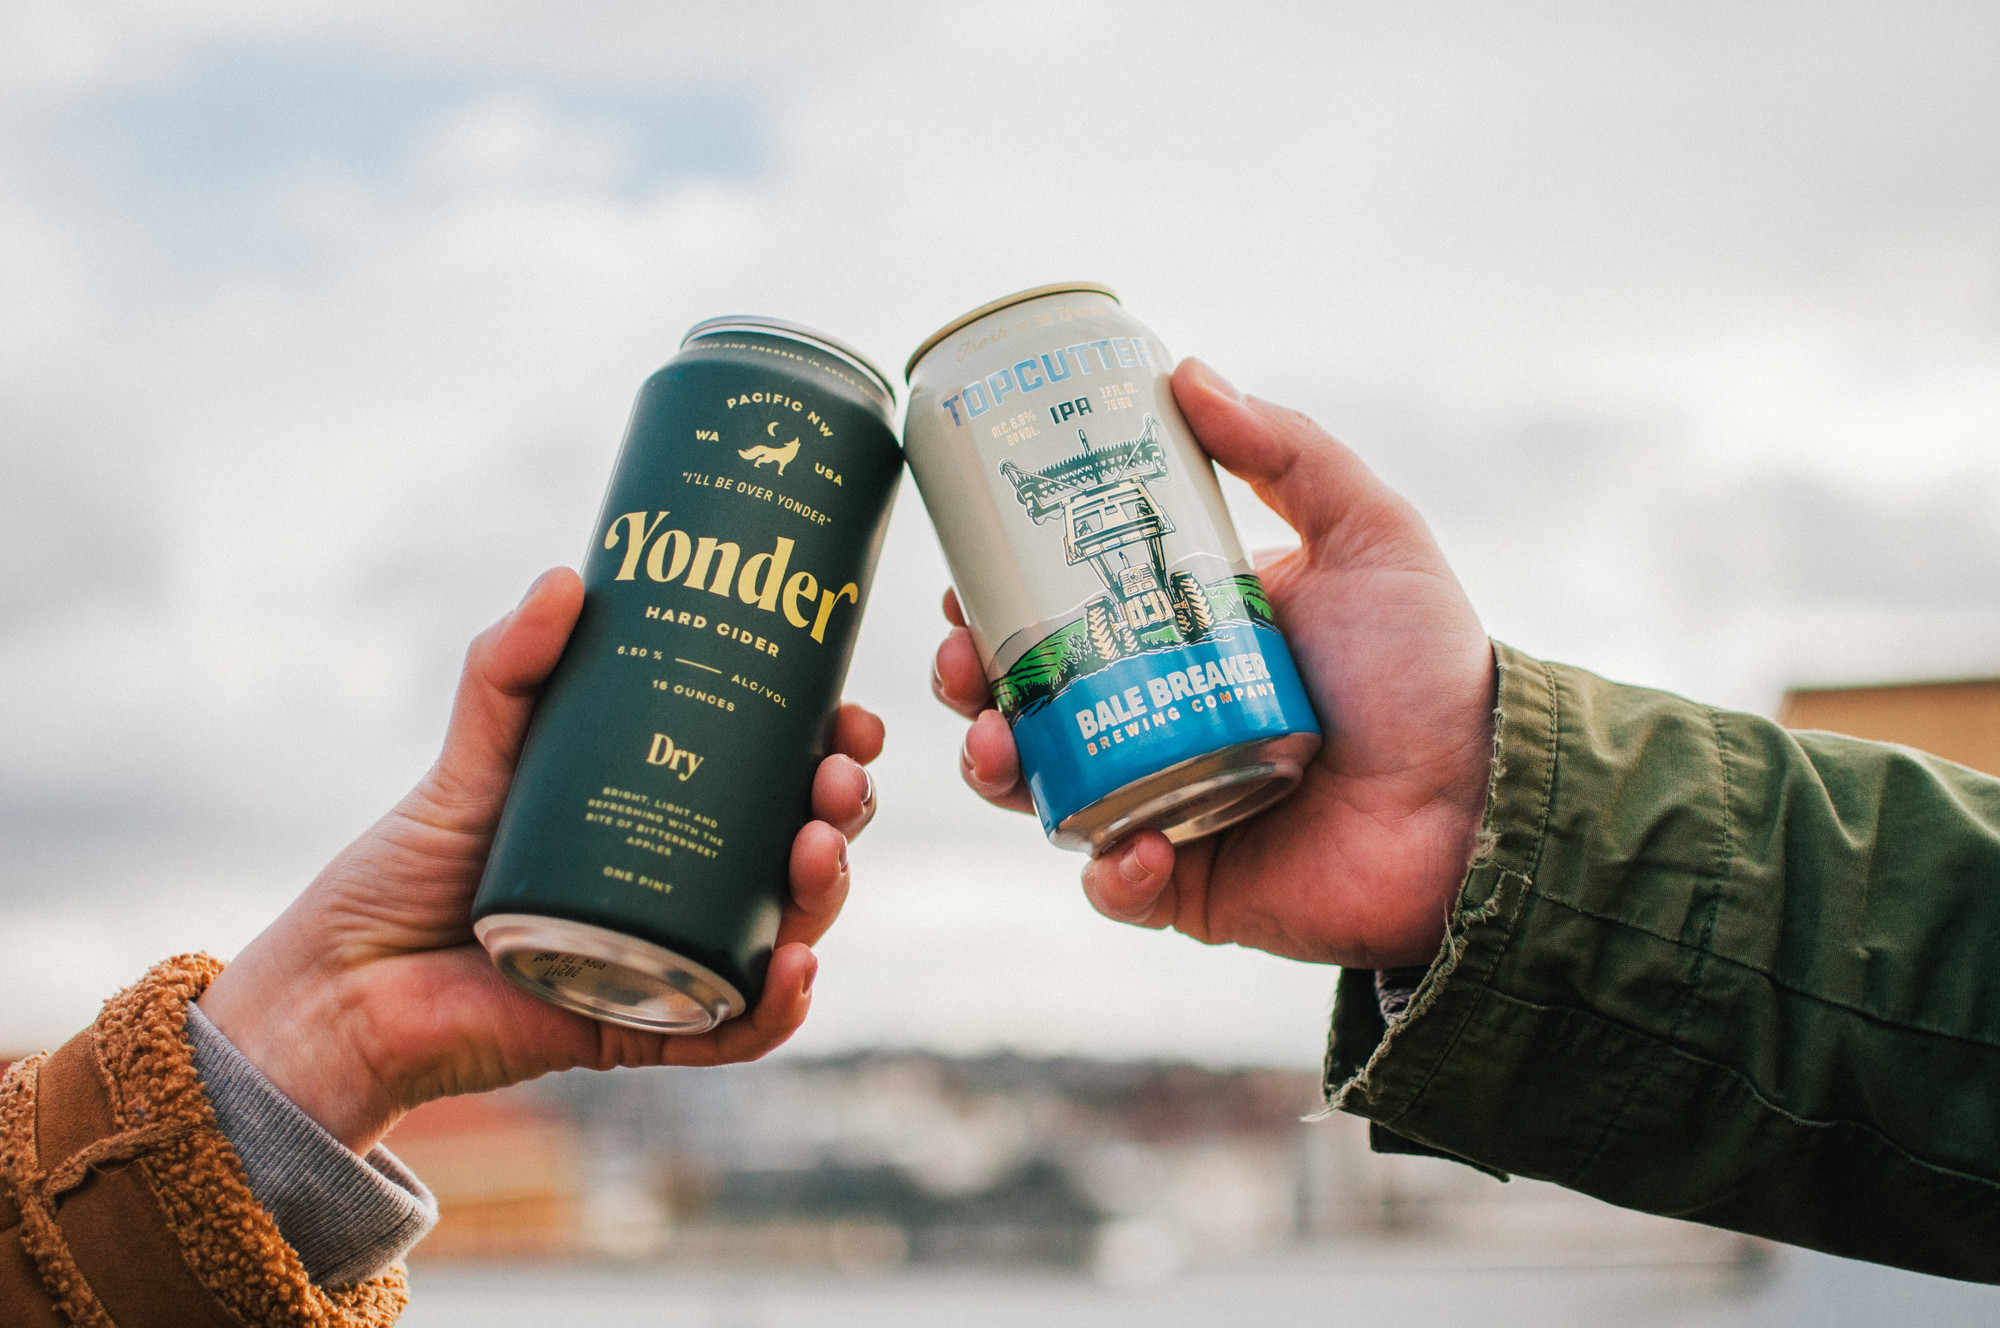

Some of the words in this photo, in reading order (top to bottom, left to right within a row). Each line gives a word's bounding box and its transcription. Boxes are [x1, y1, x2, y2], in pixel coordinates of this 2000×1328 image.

[722, 342, 747, 351] AND
[750, 344, 804, 362] PRESSED
[956, 326, 1011, 362] Fresh
[941, 336, 1156, 429] TOPCUTTER
[726, 391, 804, 413] PACIFIC
[807, 410, 834, 437] NW
[1048, 396, 1093, 425] IPA
[695, 429, 720, 442] WA
[814, 461, 843, 487] USA
[714, 475, 735, 490] BE
[736, 480, 774, 502] OVER
[777, 493, 832, 527] YONDER"
[603, 510, 859, 645] Yonder
[644, 606, 708, 629] HARD
[716, 622, 780, 658] CIDER
[617, 645, 648, 658] 6.50
[653, 650, 663, 661] %
[731, 673, 788, 708] ALC/VOL
[652, 679, 668, 691] 16
[673, 684, 736, 713] OUNCES
[1075, 685, 1148, 740] BALE
[1147, 652, 1272, 710] BREAKER
[1086, 706, 1182, 757] BREWING
[1191, 682, 1276, 713] COMPANY
[646, 732, 705, 782] Dry
[584, 812, 613, 826] BITE
[616, 818, 634, 829] OF
[635, 823, 719, 860] BITTERSWEET
[586, 798, 664, 824] REFRESHING
[667, 818, 699, 836] WITH
[702, 831, 725, 847] THE
[654, 799, 692, 817] LIGHT
[693, 813, 719, 829] AND
[625, 835, 672, 857] APPLES
[602, 865, 634, 883] ONE
[637, 874, 674, 895] PINT
